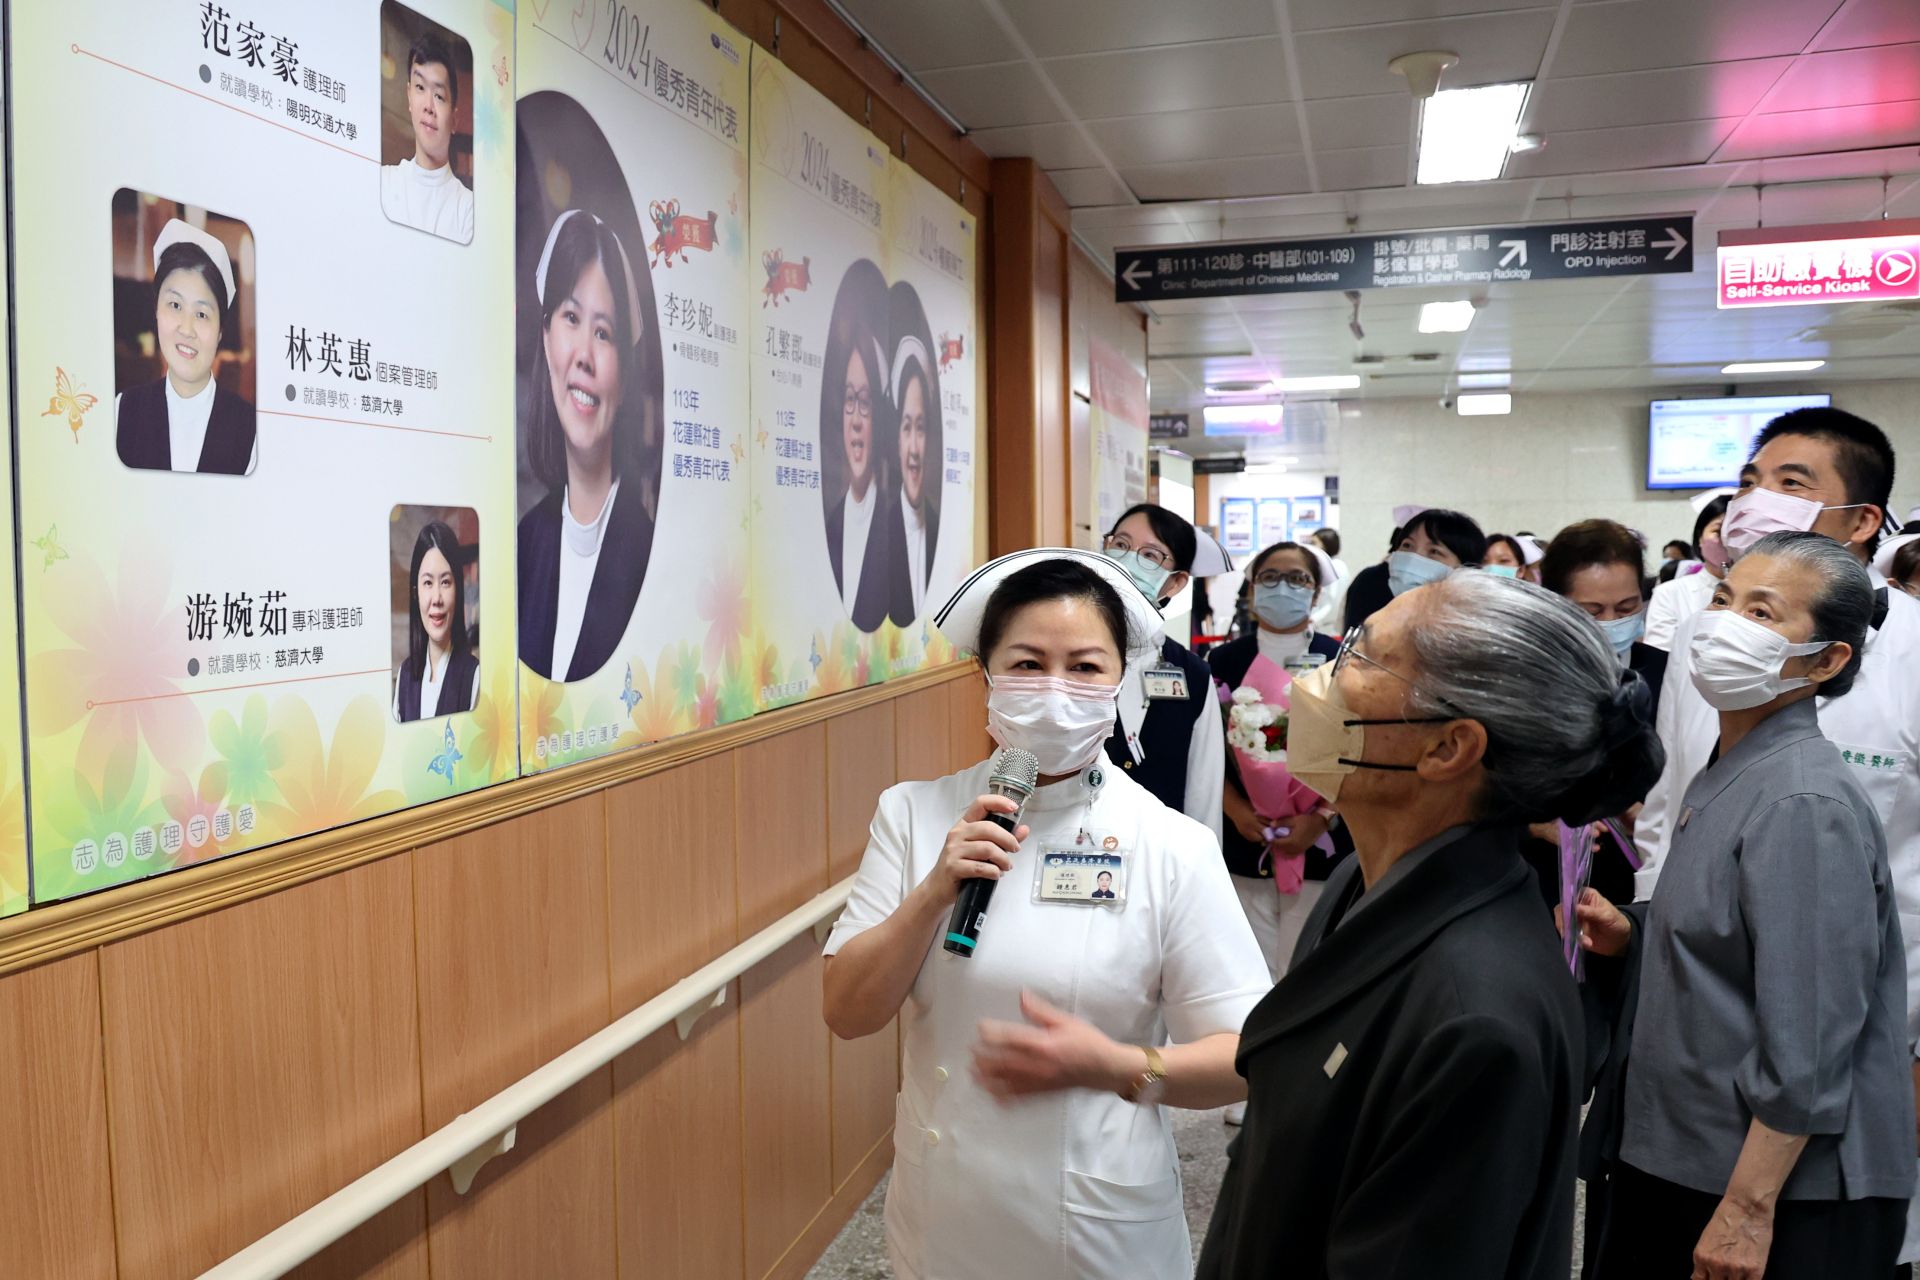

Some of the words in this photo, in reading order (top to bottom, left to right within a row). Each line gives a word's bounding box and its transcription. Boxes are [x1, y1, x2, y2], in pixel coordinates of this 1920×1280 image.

[200, 2, 299, 86] 范家豪
[303, 67, 346, 104] 護理師
[1550, 229, 1646, 253] 門診注射室
[1373, 253, 1460, 274] 影像醫學部
[1565, 256, 1593, 268] OPD
[1595, 254, 1647, 268] Injection
[1257, 274, 1295, 285] Chinese
[1296, 272, 1339, 282] Medicine
[1494, 268, 1532, 280] Radiology
[1726, 283, 1822, 298] Self-Service
[1825, 279, 1870, 293] Kiosk
[664, 292, 713, 338] 李珍妮
[285, 324, 372, 381] 林英惠
[375, 361, 438, 391] 個案管理師
[673, 389, 699, 412] 113年
[776, 410, 796, 430] 113年
[673, 420, 720, 449] 花蓮縣社會
[673, 453, 730, 482] 優秀青年代表
[185, 591, 287, 641] 游婉茹
[292, 607, 363, 632] 專科護理師
[75, 806, 253, 870] 志為護理守護愛
